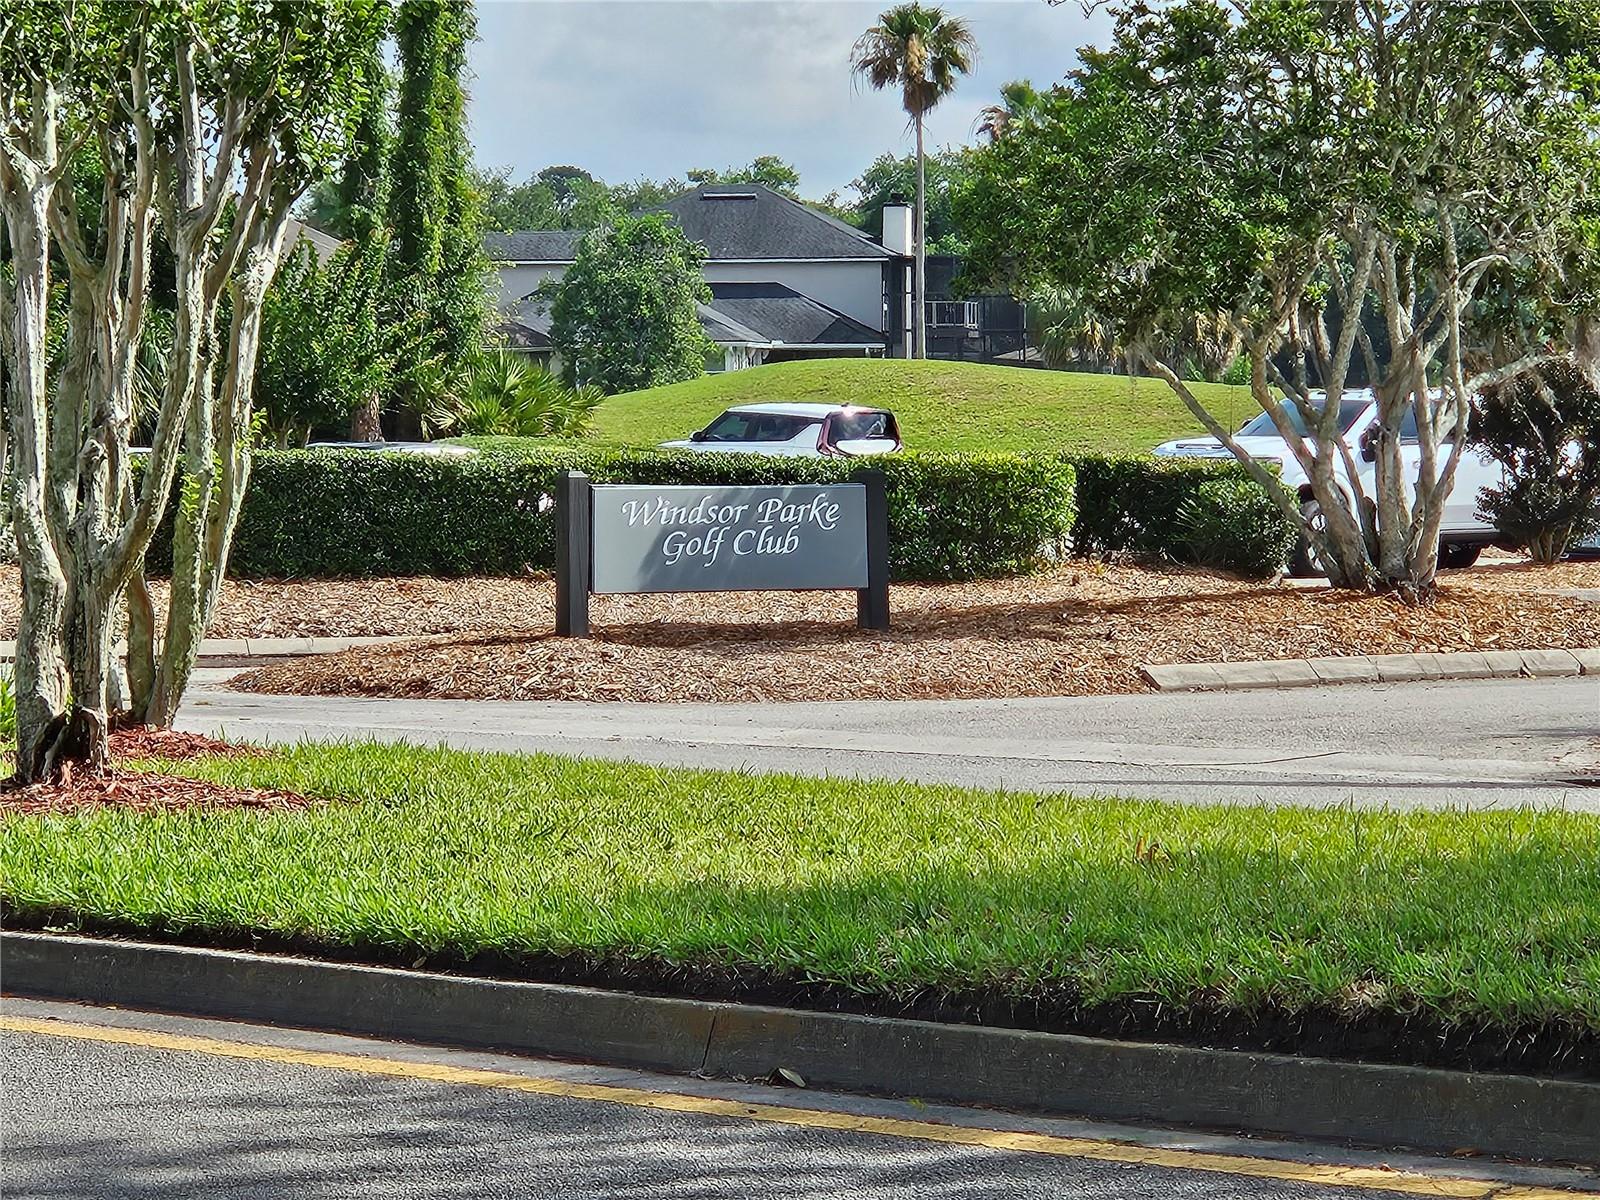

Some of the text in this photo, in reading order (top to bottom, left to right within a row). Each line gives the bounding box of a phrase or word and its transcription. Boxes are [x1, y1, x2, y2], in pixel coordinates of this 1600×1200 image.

[621, 493, 841, 530] Windsor Parke
[662, 525, 799, 567] Golf Club
